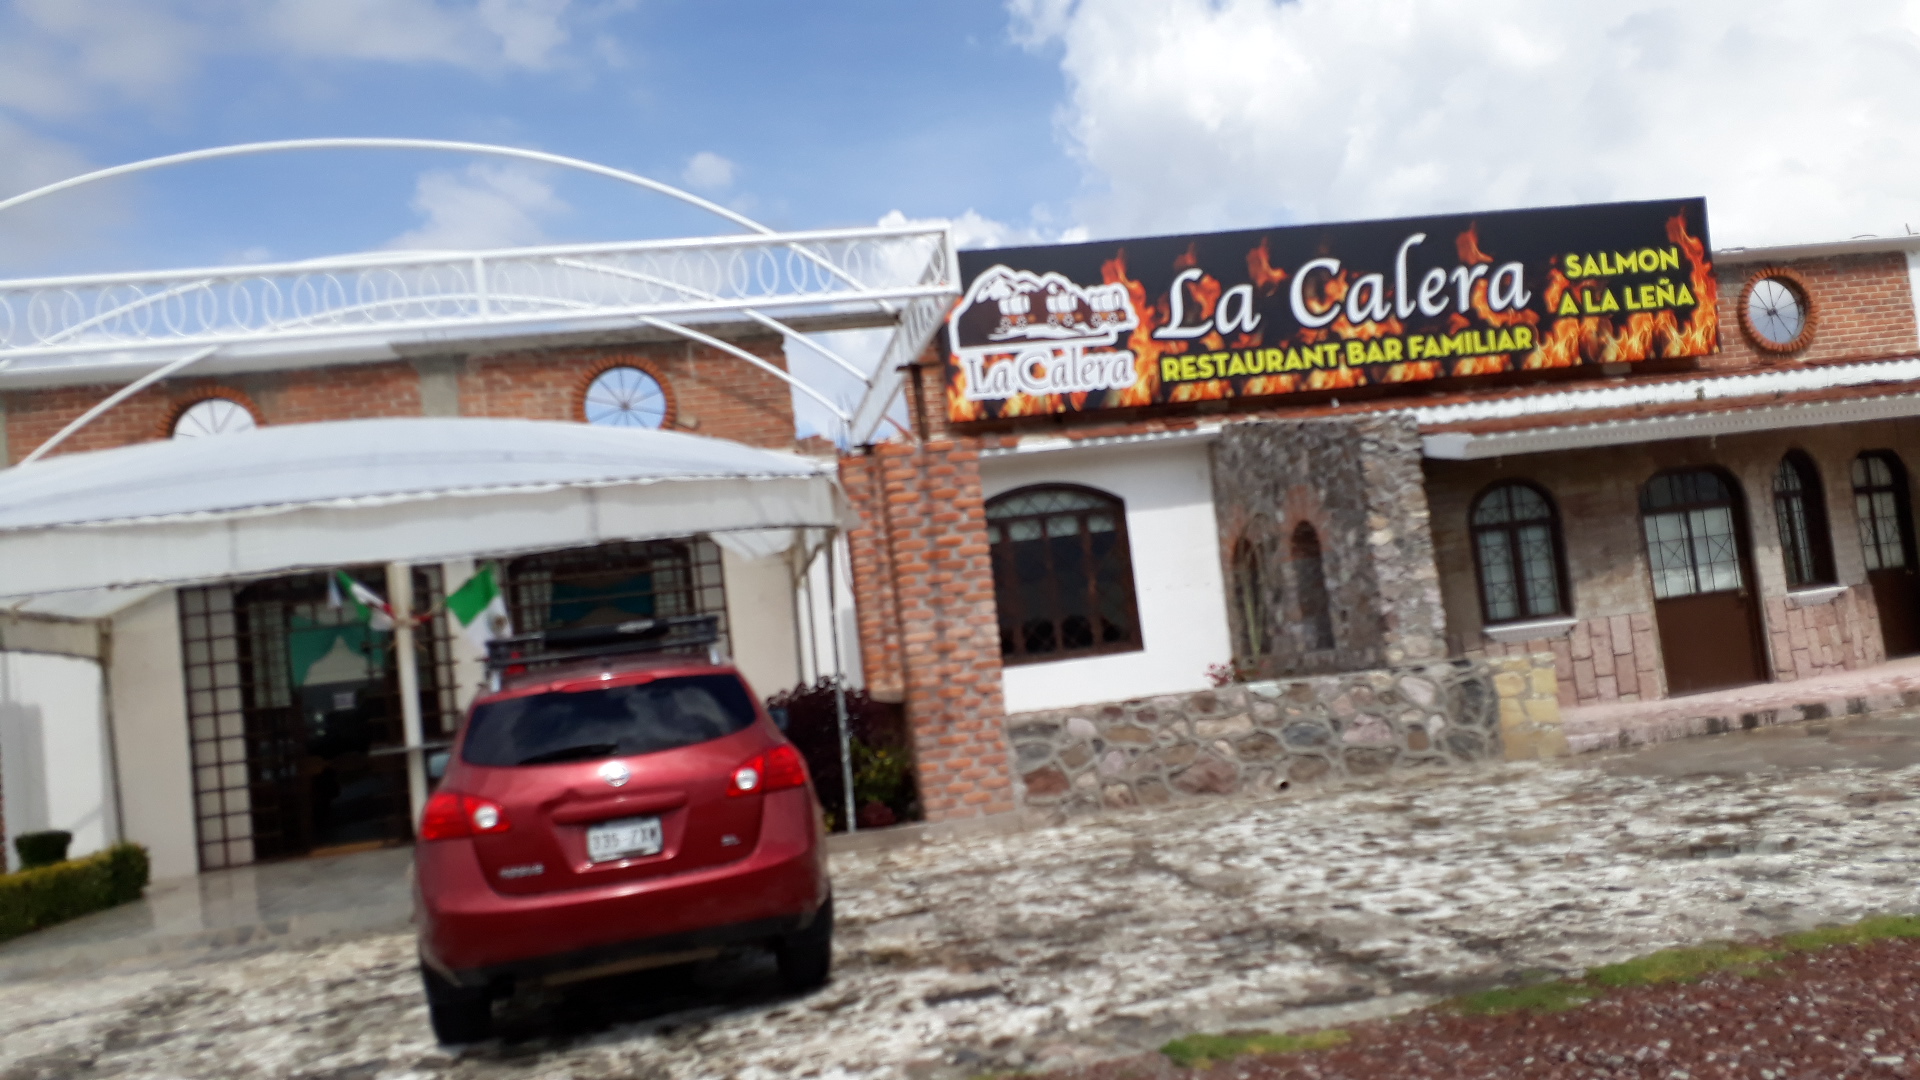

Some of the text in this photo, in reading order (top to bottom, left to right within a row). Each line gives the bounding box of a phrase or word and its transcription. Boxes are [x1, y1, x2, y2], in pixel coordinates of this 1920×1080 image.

[1152, 232, 1531, 340] La Calera
[1565, 247, 1680, 279] SALMON
[1558, 278, 1695, 317] A LA LEÑA
[966, 347, 1136, 398] La Calera
[1160, 326, 1534, 383] RESTAURANT BAR FAMILIAR
